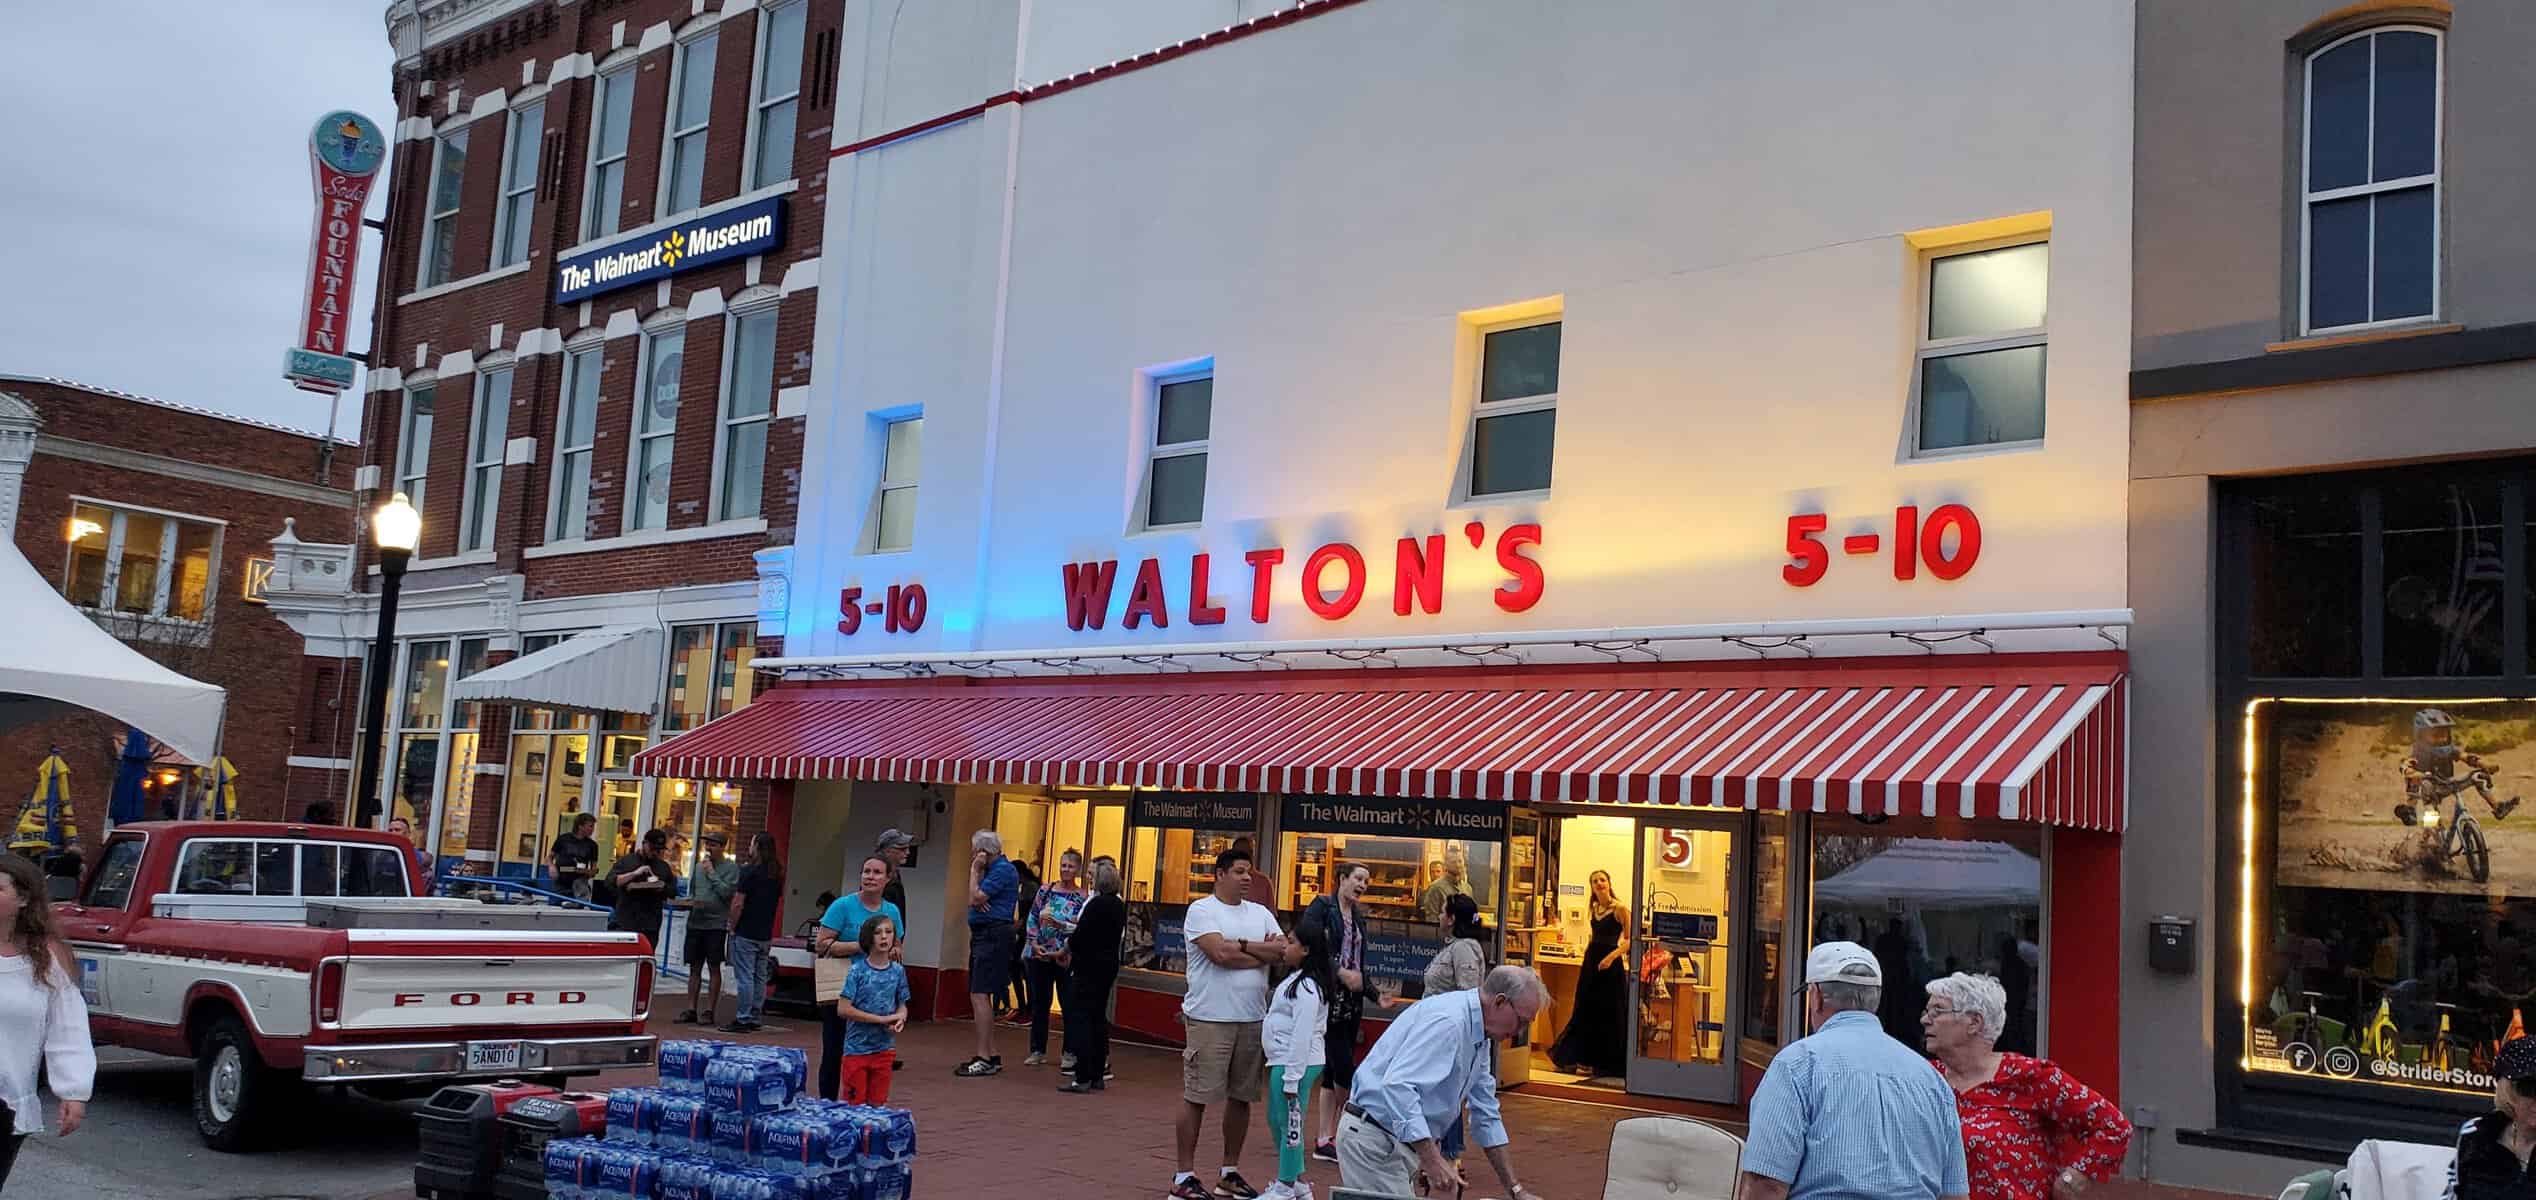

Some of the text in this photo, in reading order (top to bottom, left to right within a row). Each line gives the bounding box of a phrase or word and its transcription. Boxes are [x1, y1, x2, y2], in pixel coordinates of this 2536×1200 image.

[324, 176, 368, 202] Soda
[561, 215, 772, 292] The Walmart Museum
[313, 200, 353, 352] FOUNTAIN
[1783, 503, 1983, 587] 5-10
[1062, 521, 1545, 631] WALTON'S
[838, 583, 928, 635] 5-10
[1143, 801, 1252, 820] The Walmart Museum
[1300, 803, 1332, 821] The
[1333, 805, 1404, 825] Walmart
[1365, 940, 1396, 953] almart
[394, 991, 587, 1007] FORD
[473, 1049, 514, 1065] 5AND10
